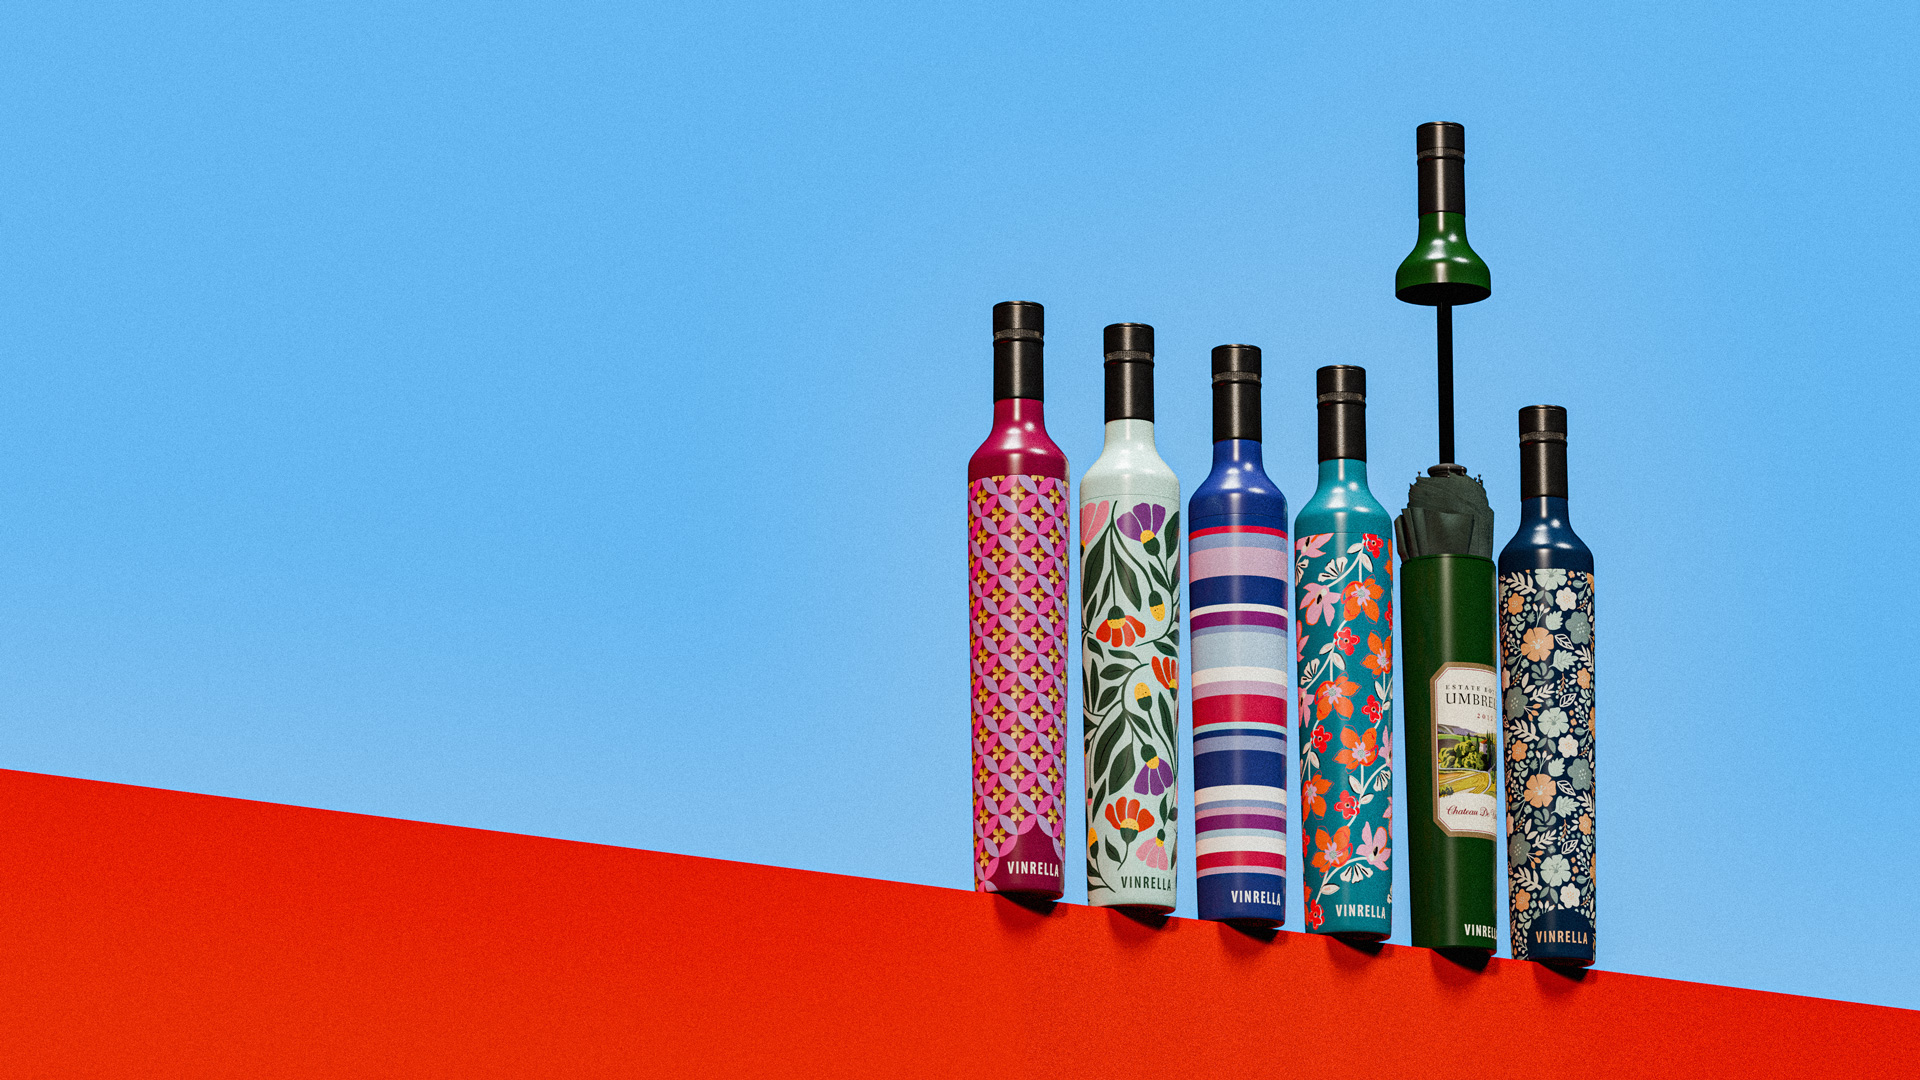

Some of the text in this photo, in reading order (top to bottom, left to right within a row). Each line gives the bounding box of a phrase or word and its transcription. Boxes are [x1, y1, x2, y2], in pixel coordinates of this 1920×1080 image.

[1445, 684, 1481, 692] ESTATE
[1446, 804, 1479, 816] Chateau
[1007, 861, 1059, 878] VINRELLA
[1121, 876, 1172, 892] VINRELLA
[1231, 890, 1281, 906] VINRELLA
[1335, 904, 1386, 919] VINRELLA
[1535, 930, 1588, 945] VINRELLA
